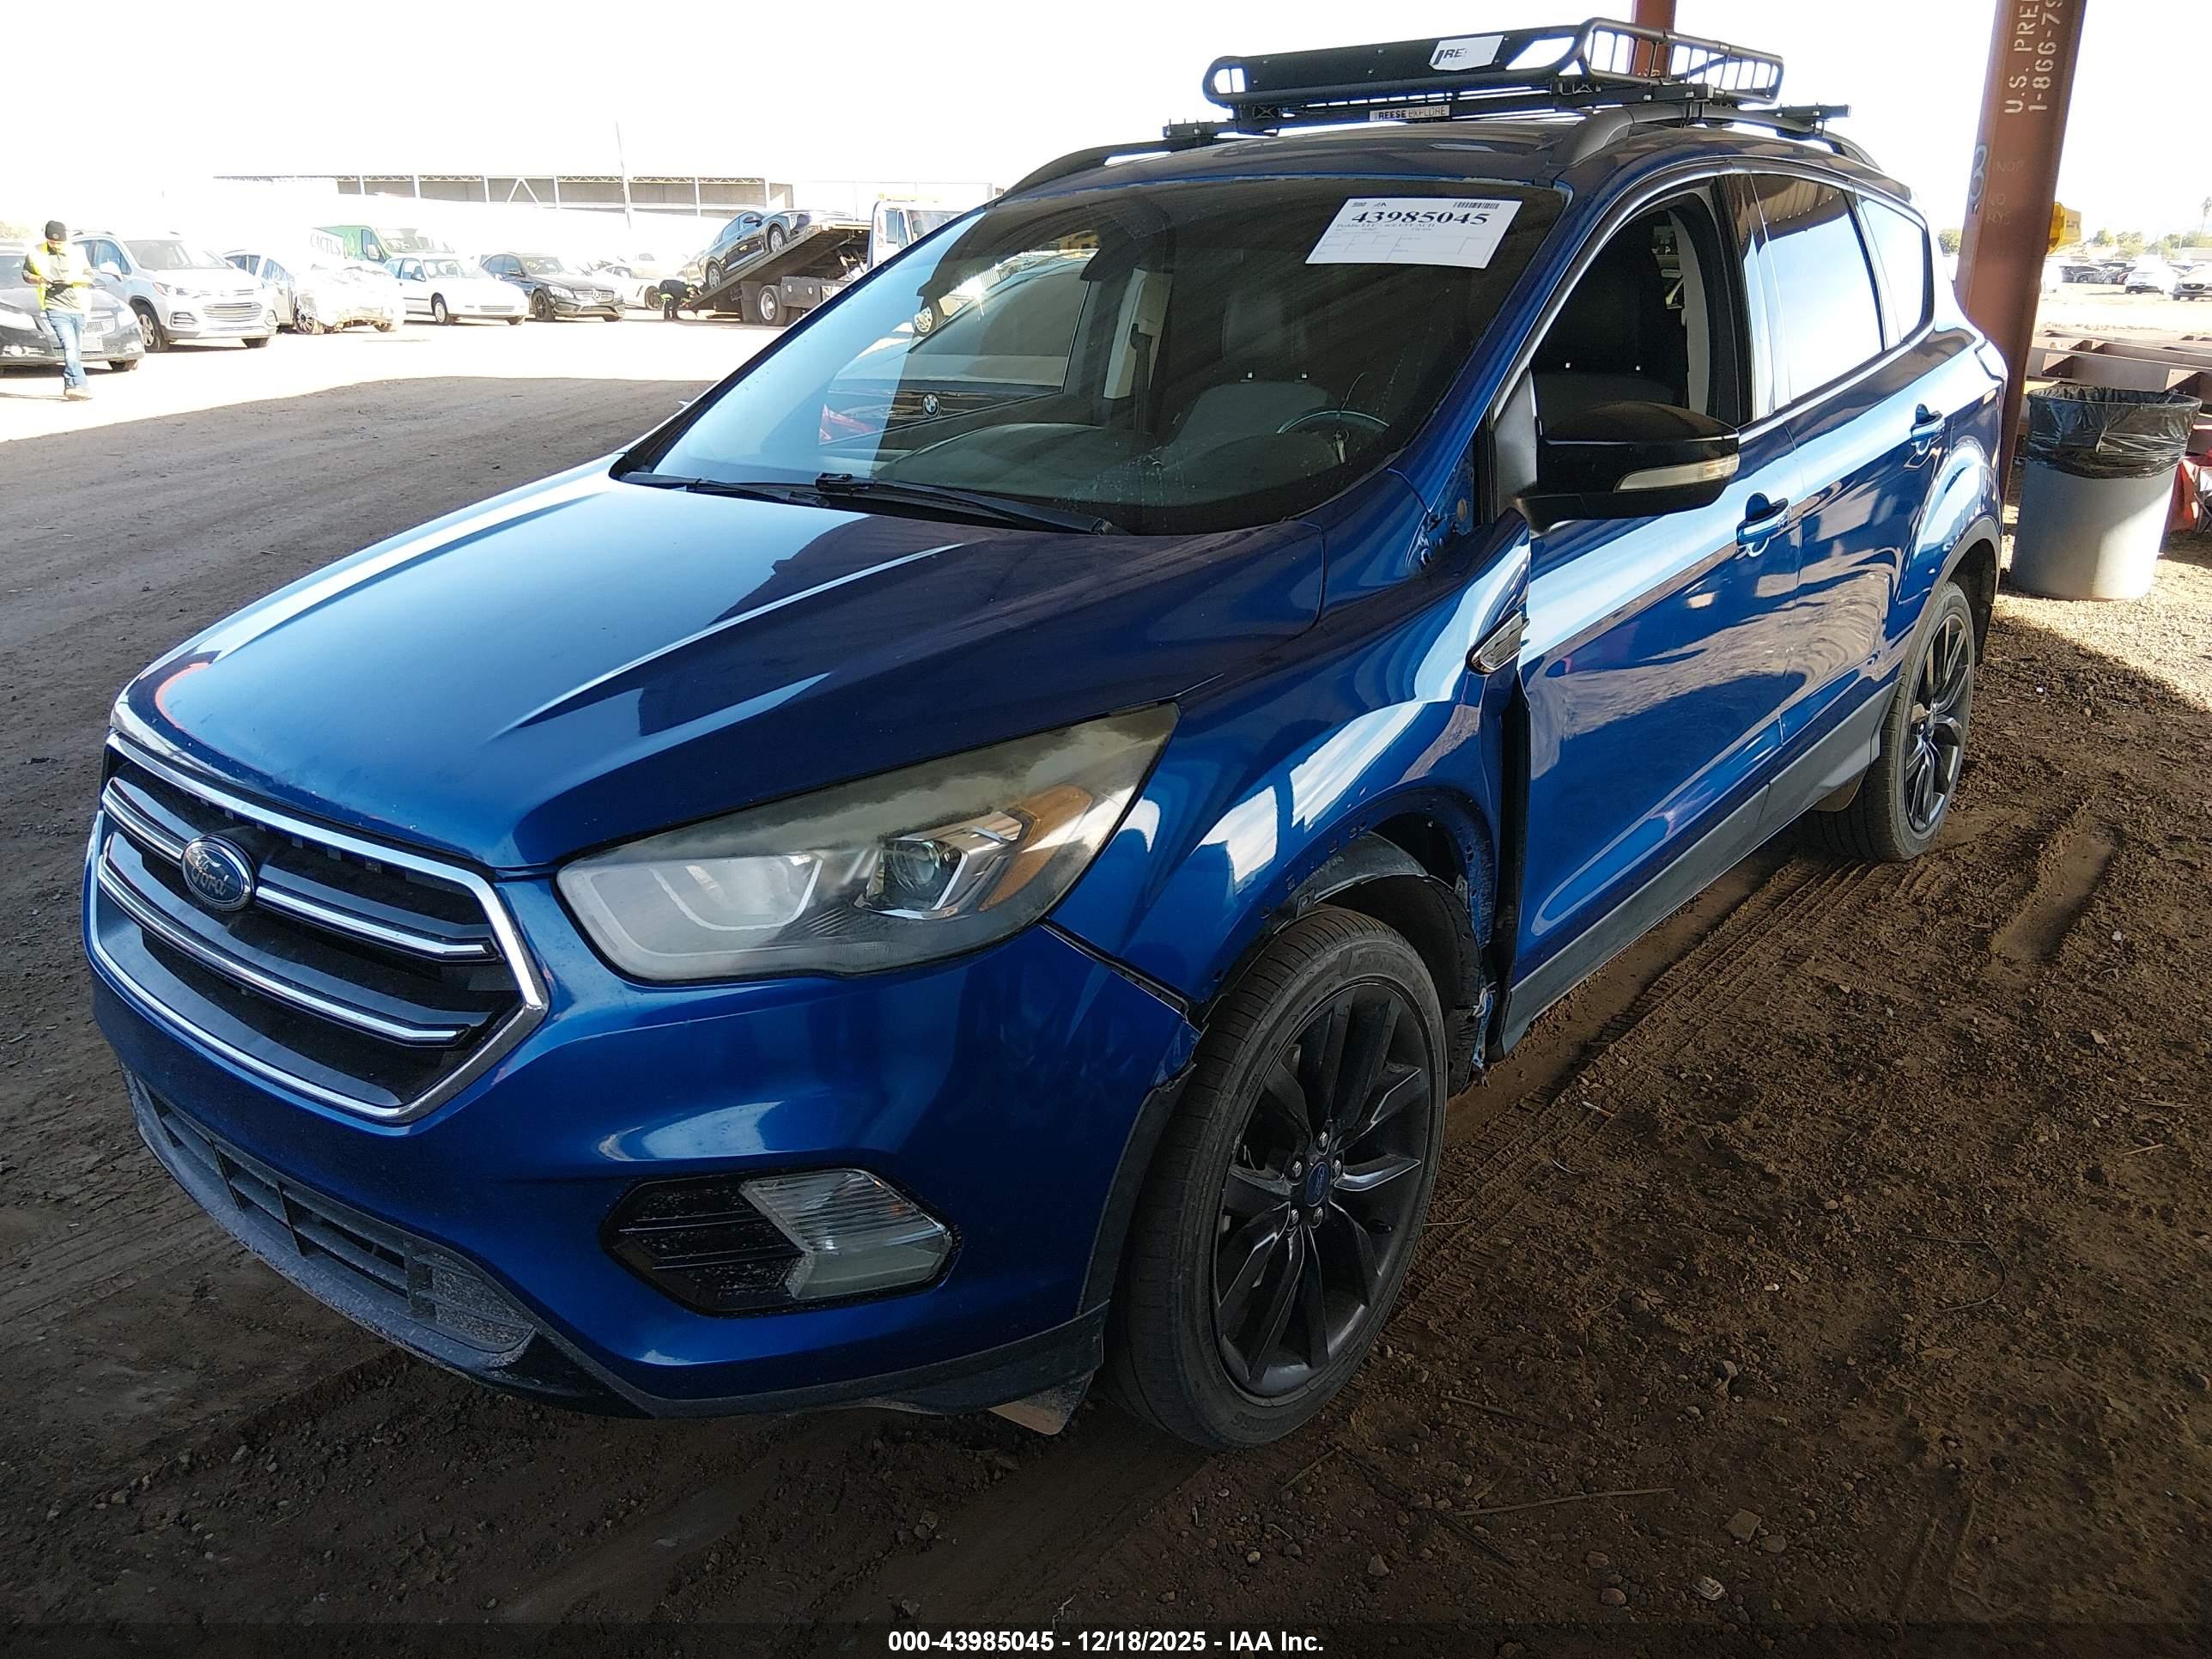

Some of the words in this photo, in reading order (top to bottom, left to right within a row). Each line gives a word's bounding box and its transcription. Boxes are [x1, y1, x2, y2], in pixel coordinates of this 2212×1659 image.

[2013, 0, 2039, 52] PRE
[2003, 67, 2030, 113] U.S.
[1378, 109, 1407, 120] REESE
[1351, 210, 1492, 226] 43985045
